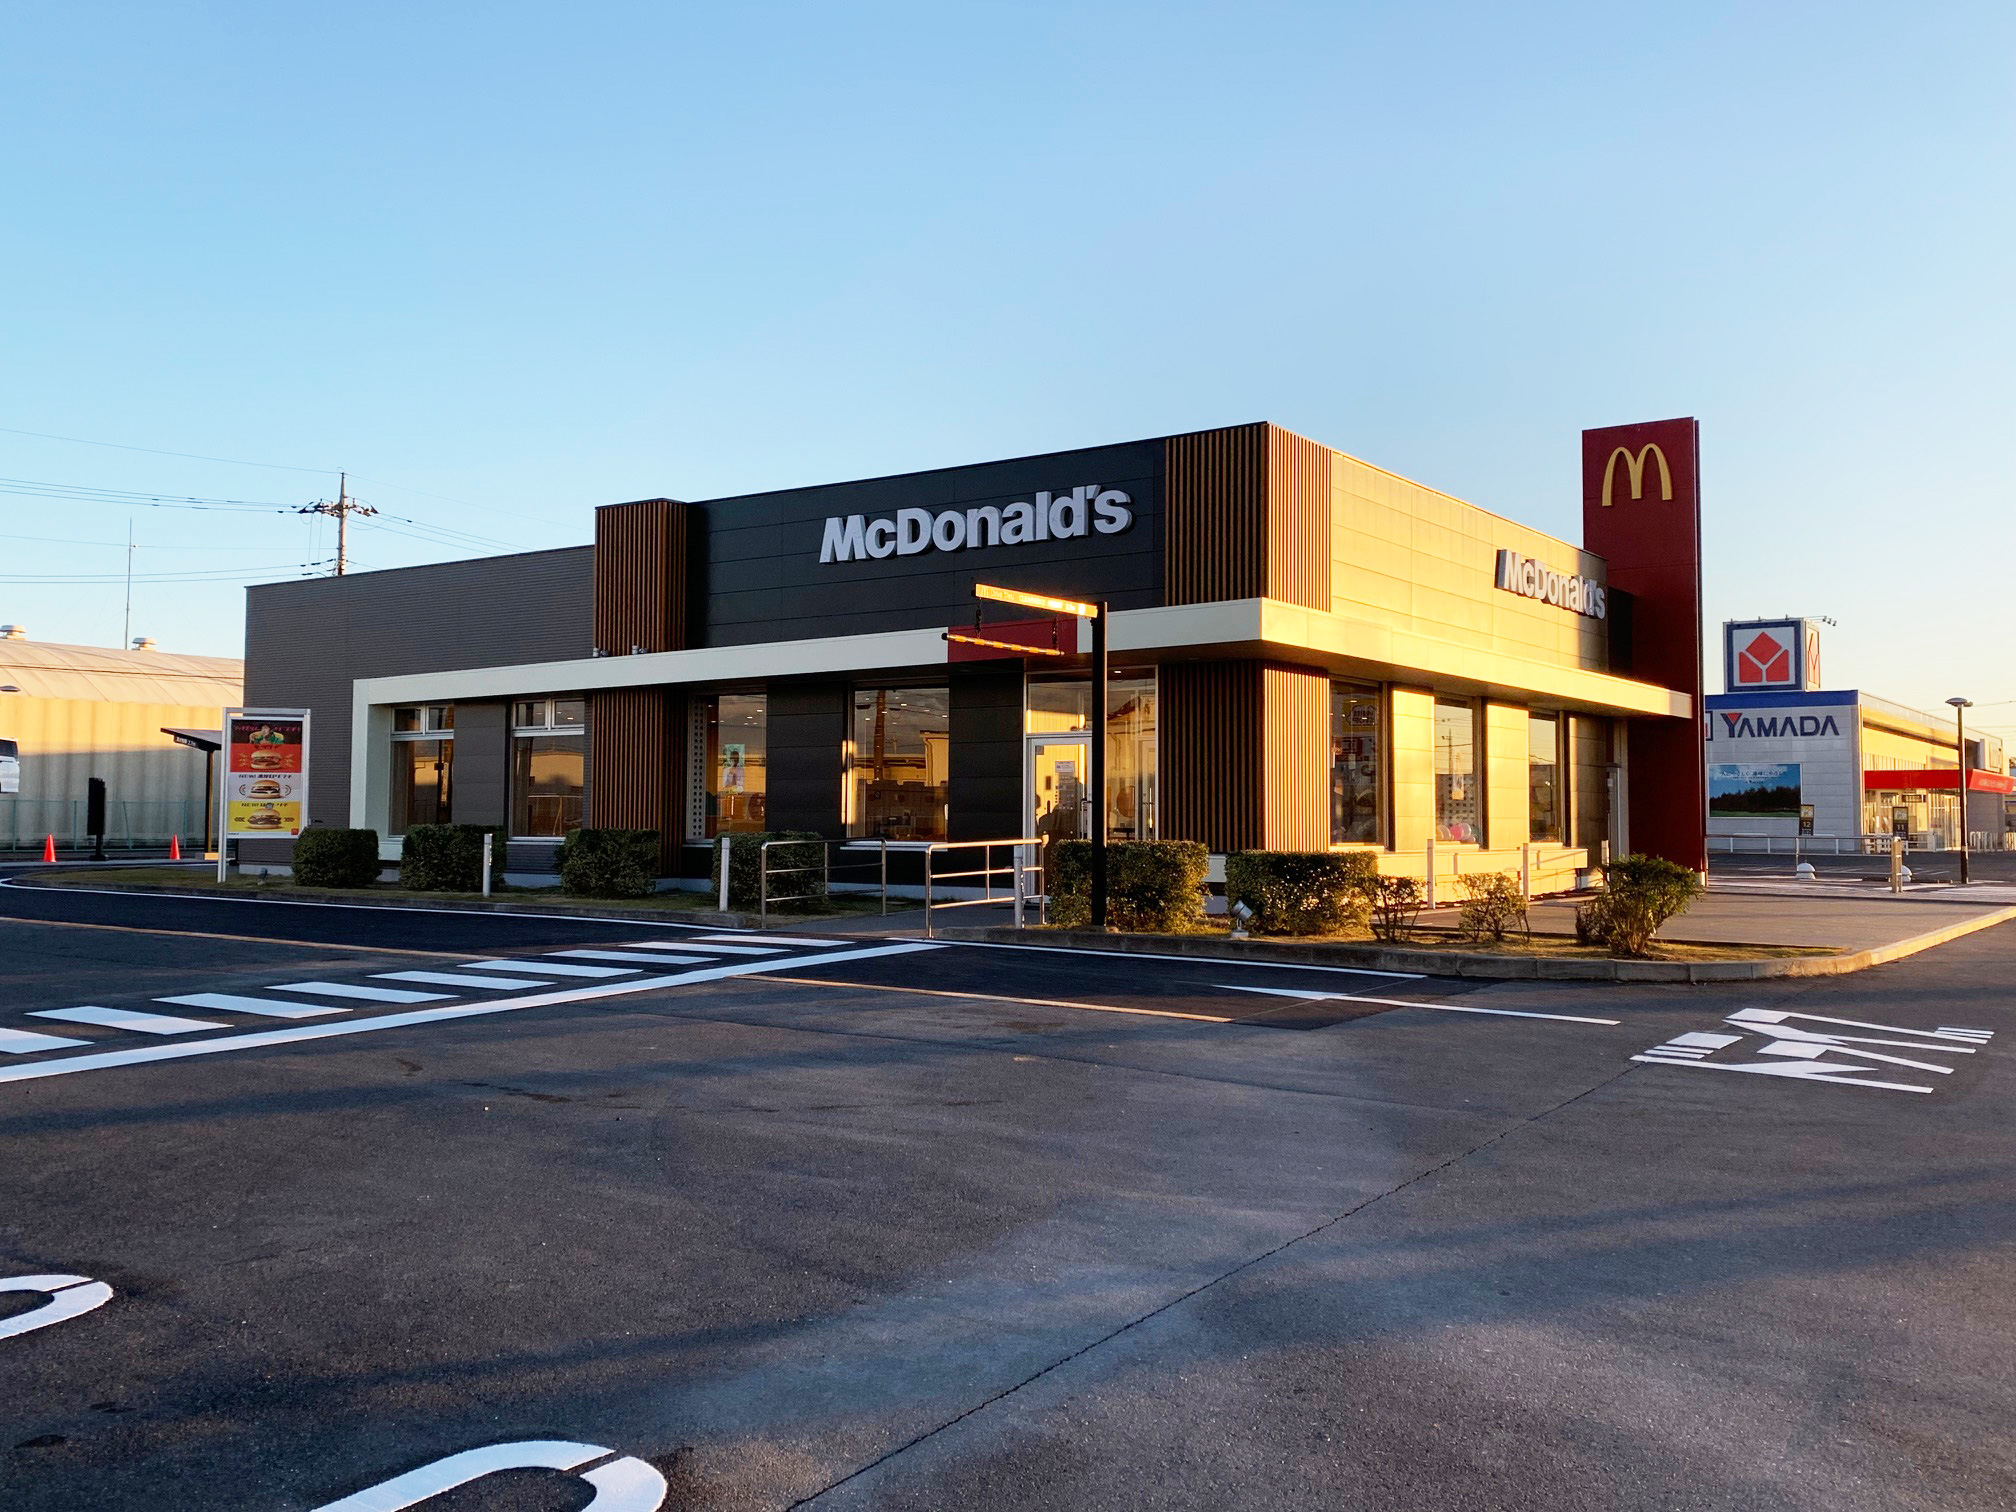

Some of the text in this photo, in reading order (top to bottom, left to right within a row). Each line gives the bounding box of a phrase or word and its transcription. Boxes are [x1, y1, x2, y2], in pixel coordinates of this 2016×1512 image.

[818, 484, 1133, 564] McDonald's
[1497, 548, 1606, 620] McDonald's
[1720, 712, 1840, 738] YAMADA
